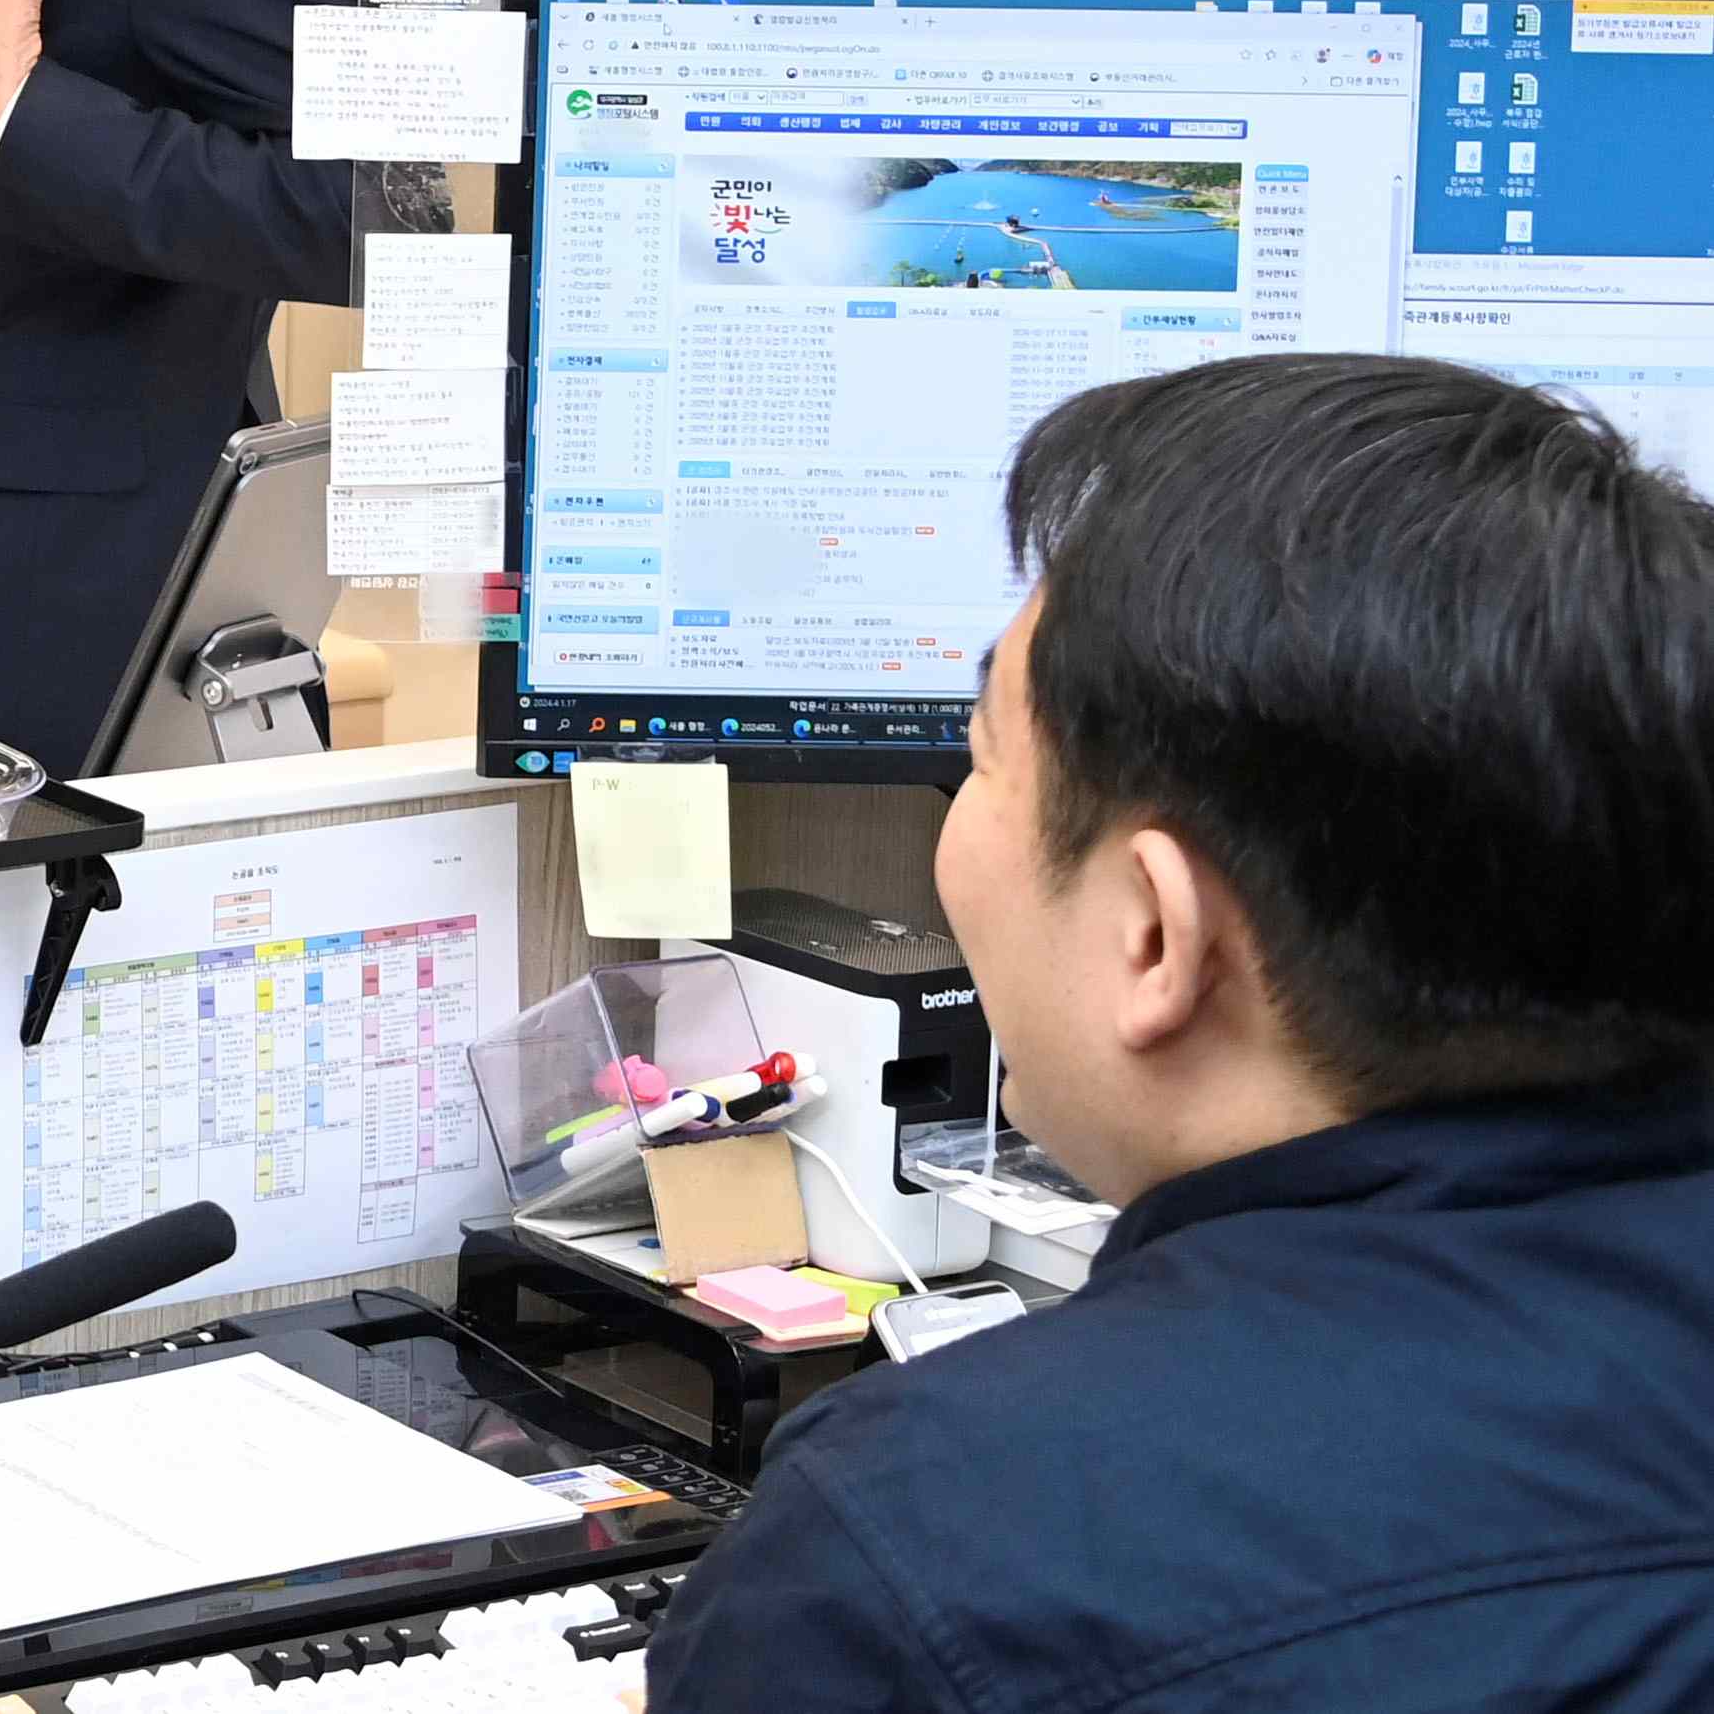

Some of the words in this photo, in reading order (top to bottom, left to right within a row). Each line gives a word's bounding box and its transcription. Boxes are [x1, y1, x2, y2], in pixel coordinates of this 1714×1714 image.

[710, 179, 772, 200] 군민이
[724, 205, 792, 234] 빛나는
[715, 237, 766, 264] 달성
[922, 989, 976, 1009] brother
